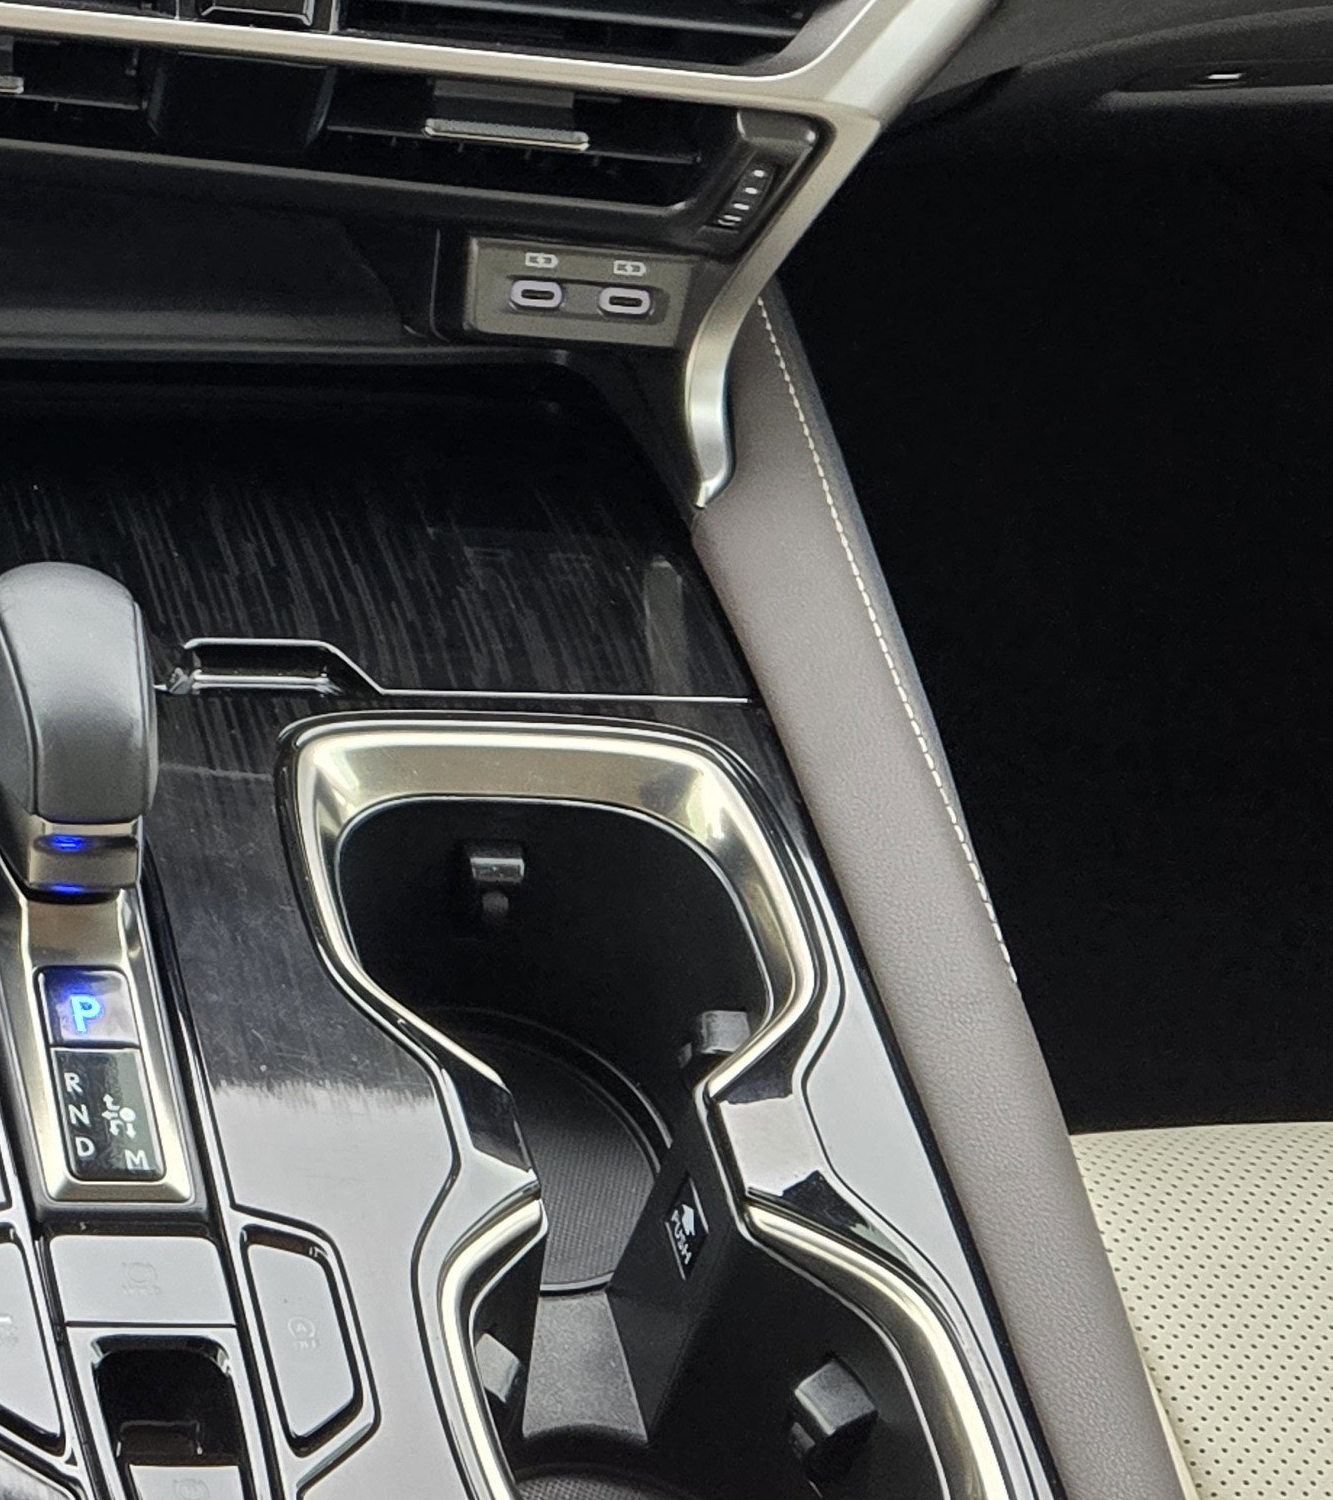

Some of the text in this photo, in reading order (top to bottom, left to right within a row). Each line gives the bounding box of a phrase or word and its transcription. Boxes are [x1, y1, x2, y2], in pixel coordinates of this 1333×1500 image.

[69, 994, 102, 1033] P
[64, 1072, 83, 1094] R
[68, 1104, 91, 1127] N
[75, 1136, 96, 1158] D
[124, 1149, 149, 1171] M
